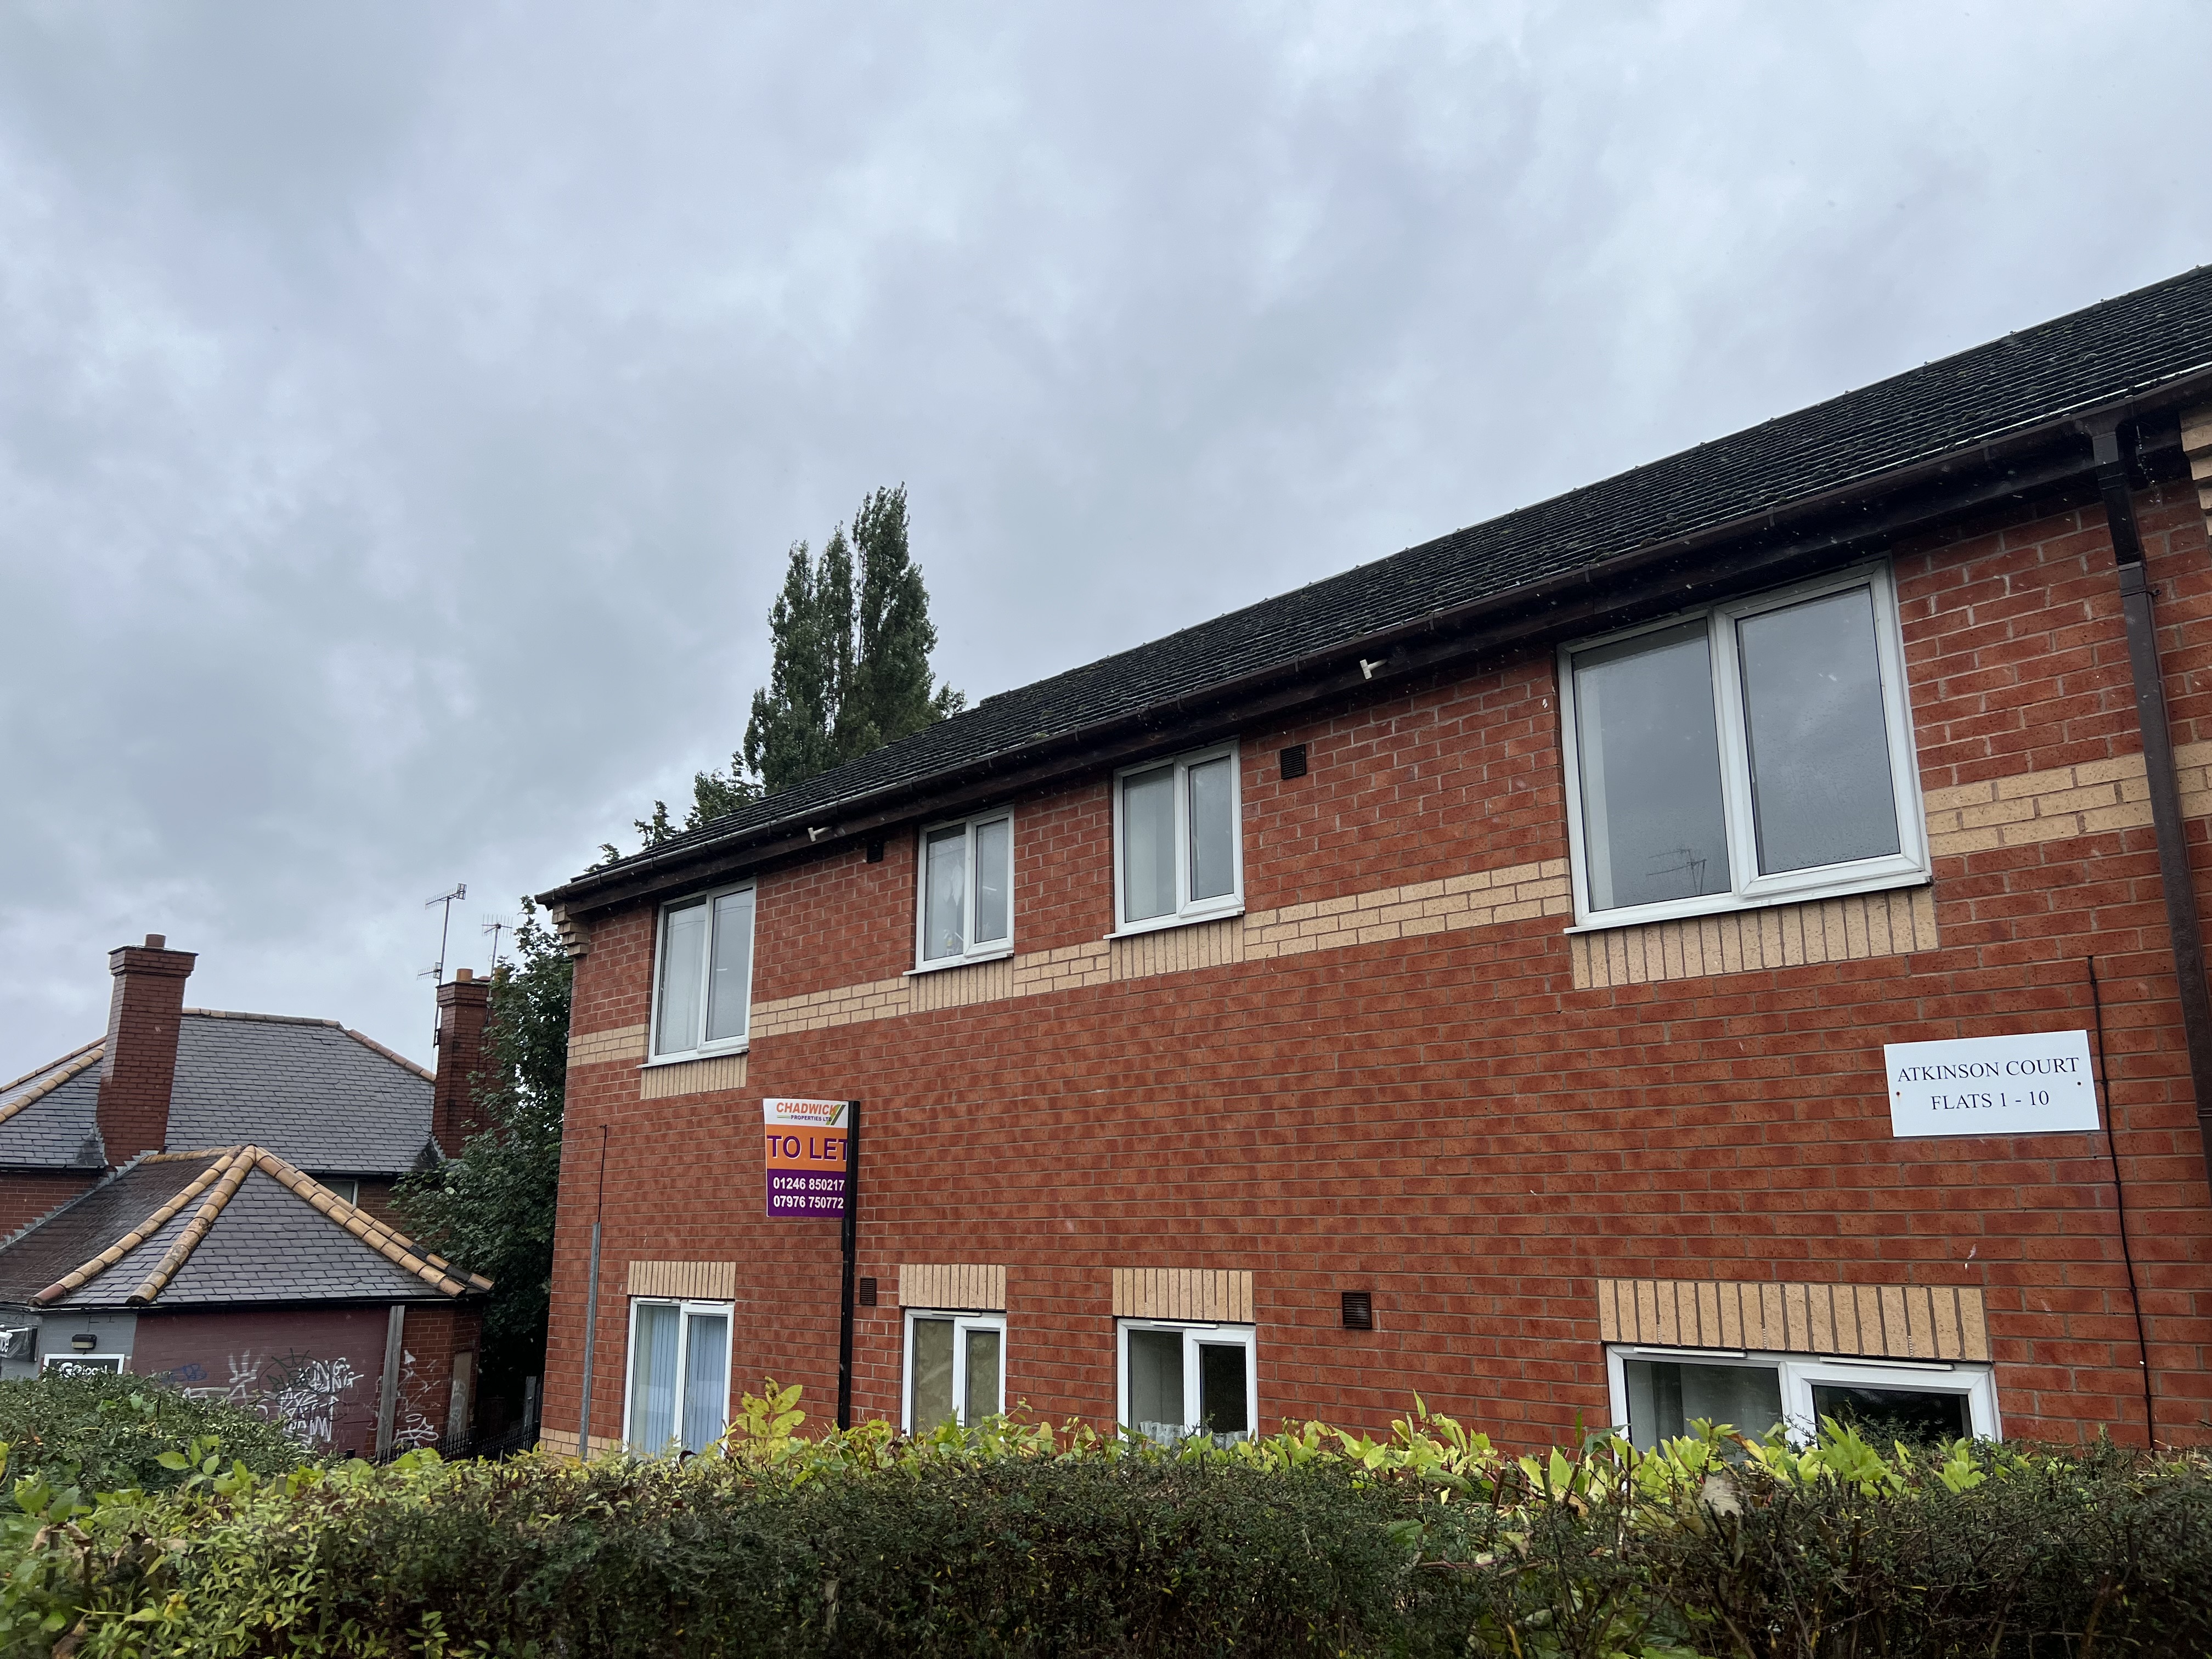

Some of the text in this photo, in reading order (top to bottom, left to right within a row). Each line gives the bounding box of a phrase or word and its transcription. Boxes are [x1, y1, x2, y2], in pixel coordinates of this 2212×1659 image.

[1897, 1057, 2079, 1082] ATKINSON COURT
[1931, 1093, 1993, 1110] FLATS
[2000, 1092, 2007, 1107] 1
[2029, 1090, 2050, 1106] 10
[776, 1102, 838, 1116] CHADWICK
[767, 1135, 848, 1162] TO LET
[773, 1177, 845, 1191] 01246 850217
[773, 1195, 844, 1209] 07976 750772
